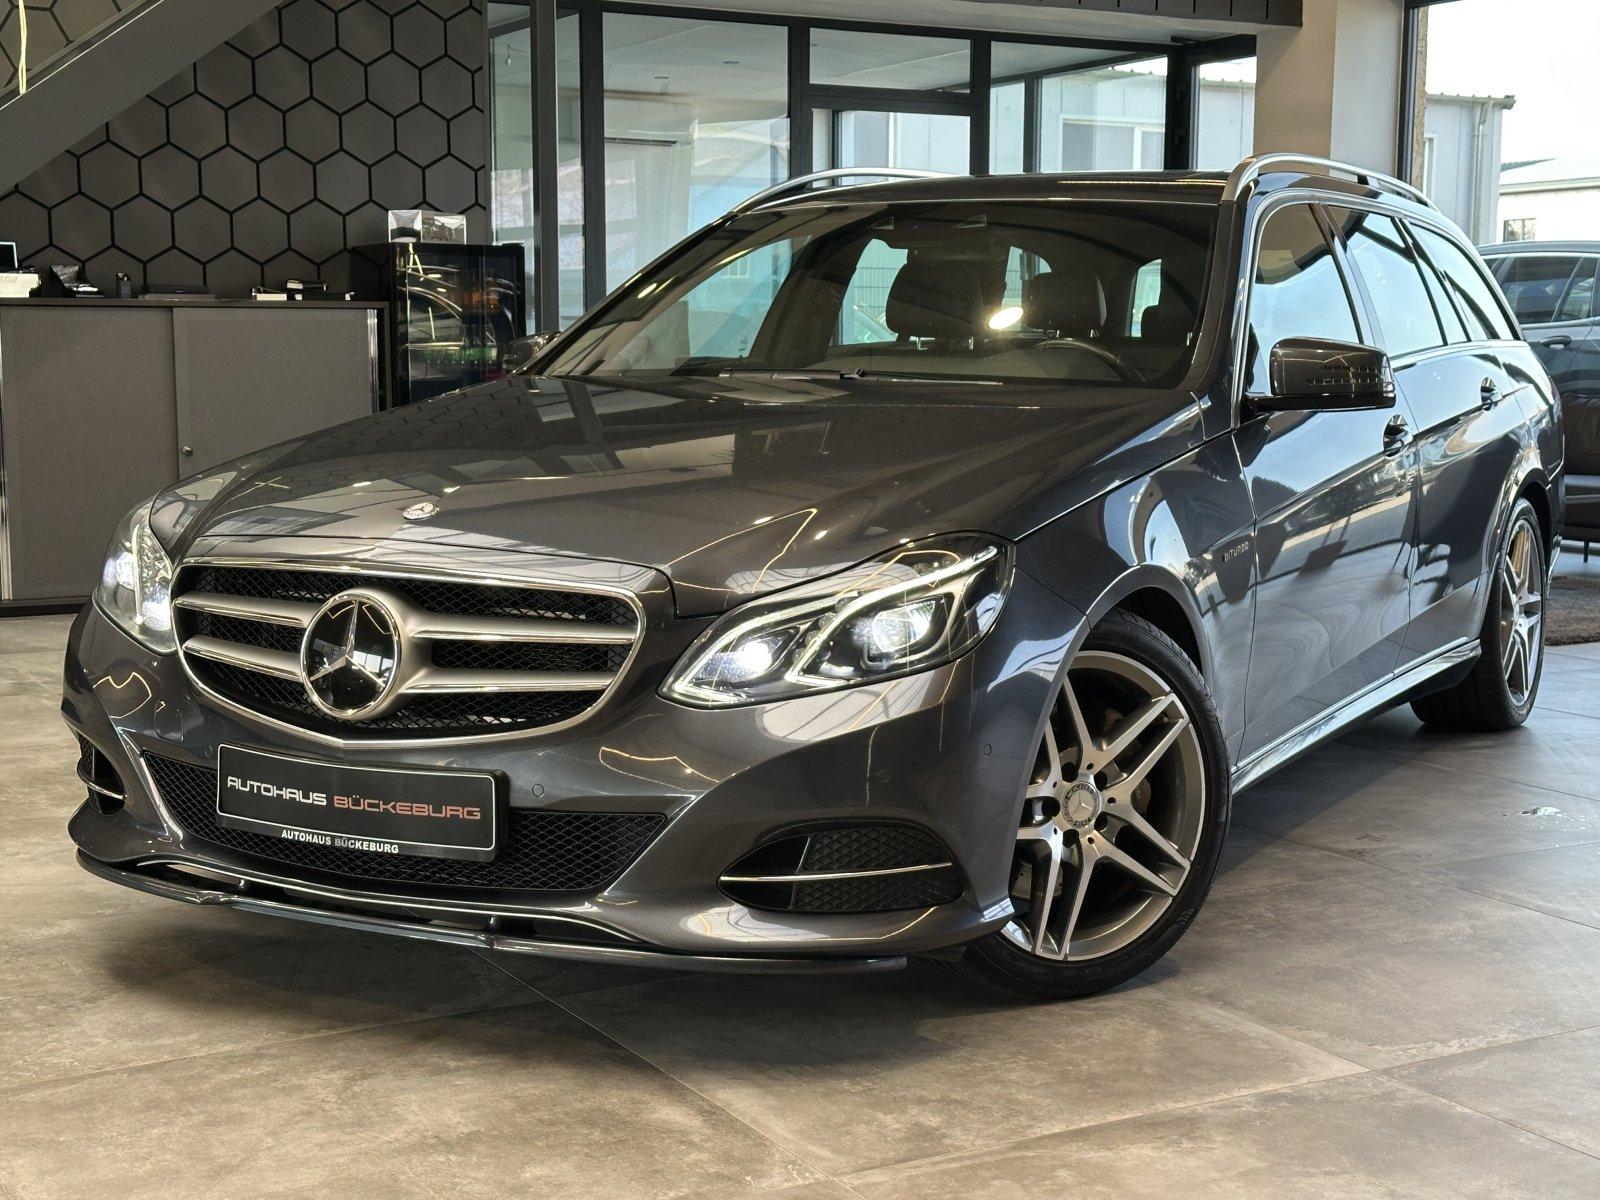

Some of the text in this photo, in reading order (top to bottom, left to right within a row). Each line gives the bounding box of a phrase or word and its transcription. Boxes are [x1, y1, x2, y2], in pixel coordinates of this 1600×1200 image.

[227, 775, 481, 820] AUTOHAUS BÜCKEBURG
[281, 829, 399, 854] AUTOHAUS BÜCKEBURG
